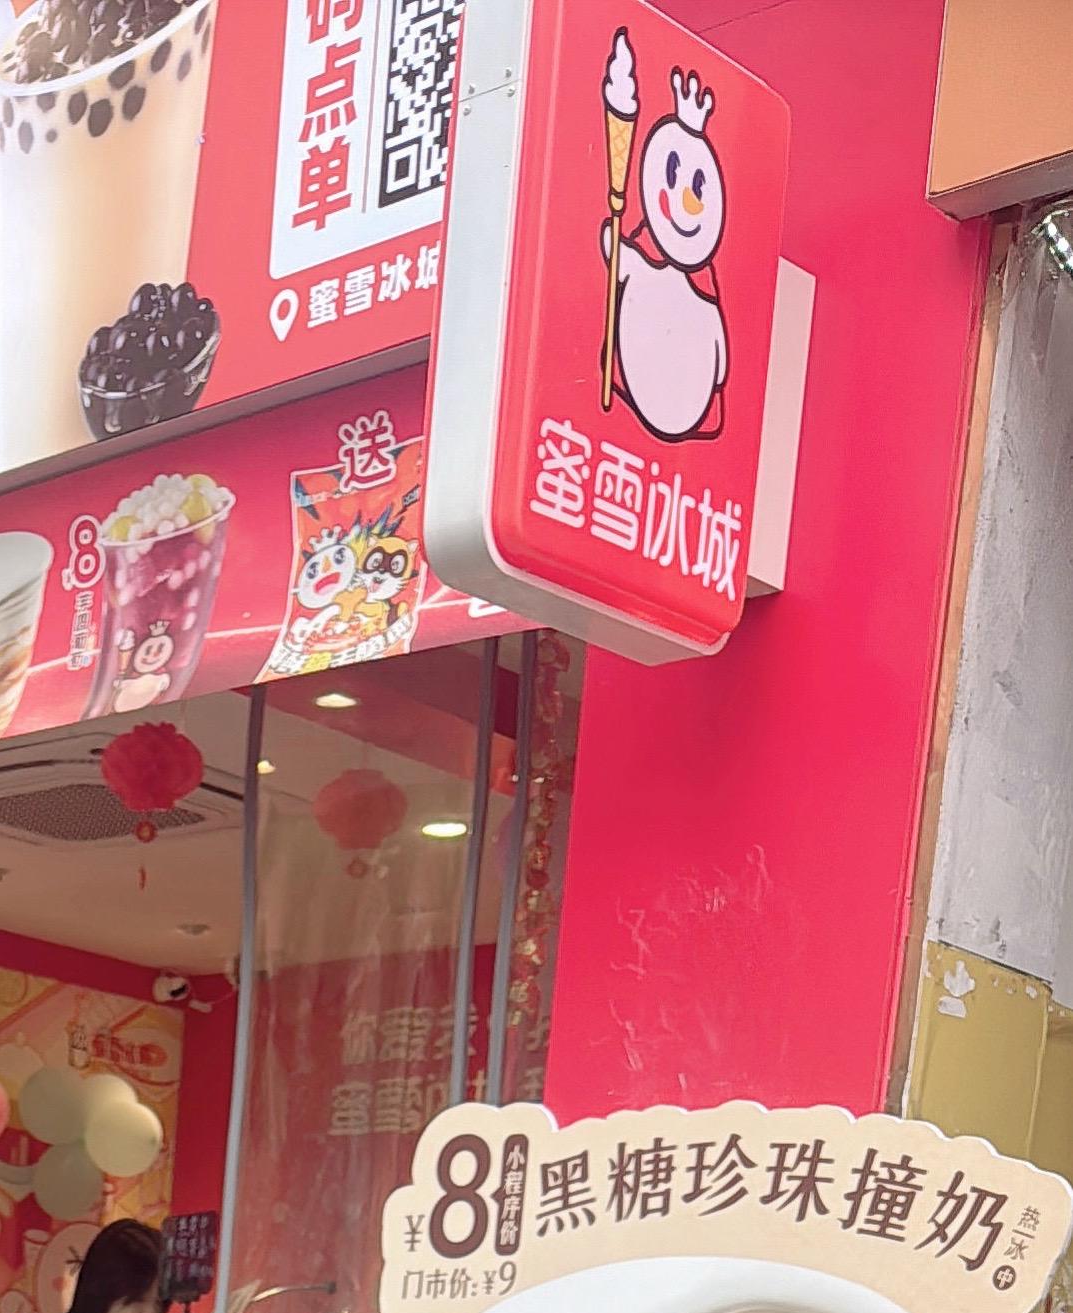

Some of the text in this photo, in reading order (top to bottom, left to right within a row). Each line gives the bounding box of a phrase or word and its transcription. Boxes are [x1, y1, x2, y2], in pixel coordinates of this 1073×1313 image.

[342, 414, 393, 488] 送
[530, 418, 743, 601] 蜜雪冰城
[499, 1144, 526, 1246] 小程序价
[535, 1132, 1009, 1272] 黑糖珍珠撞奶
